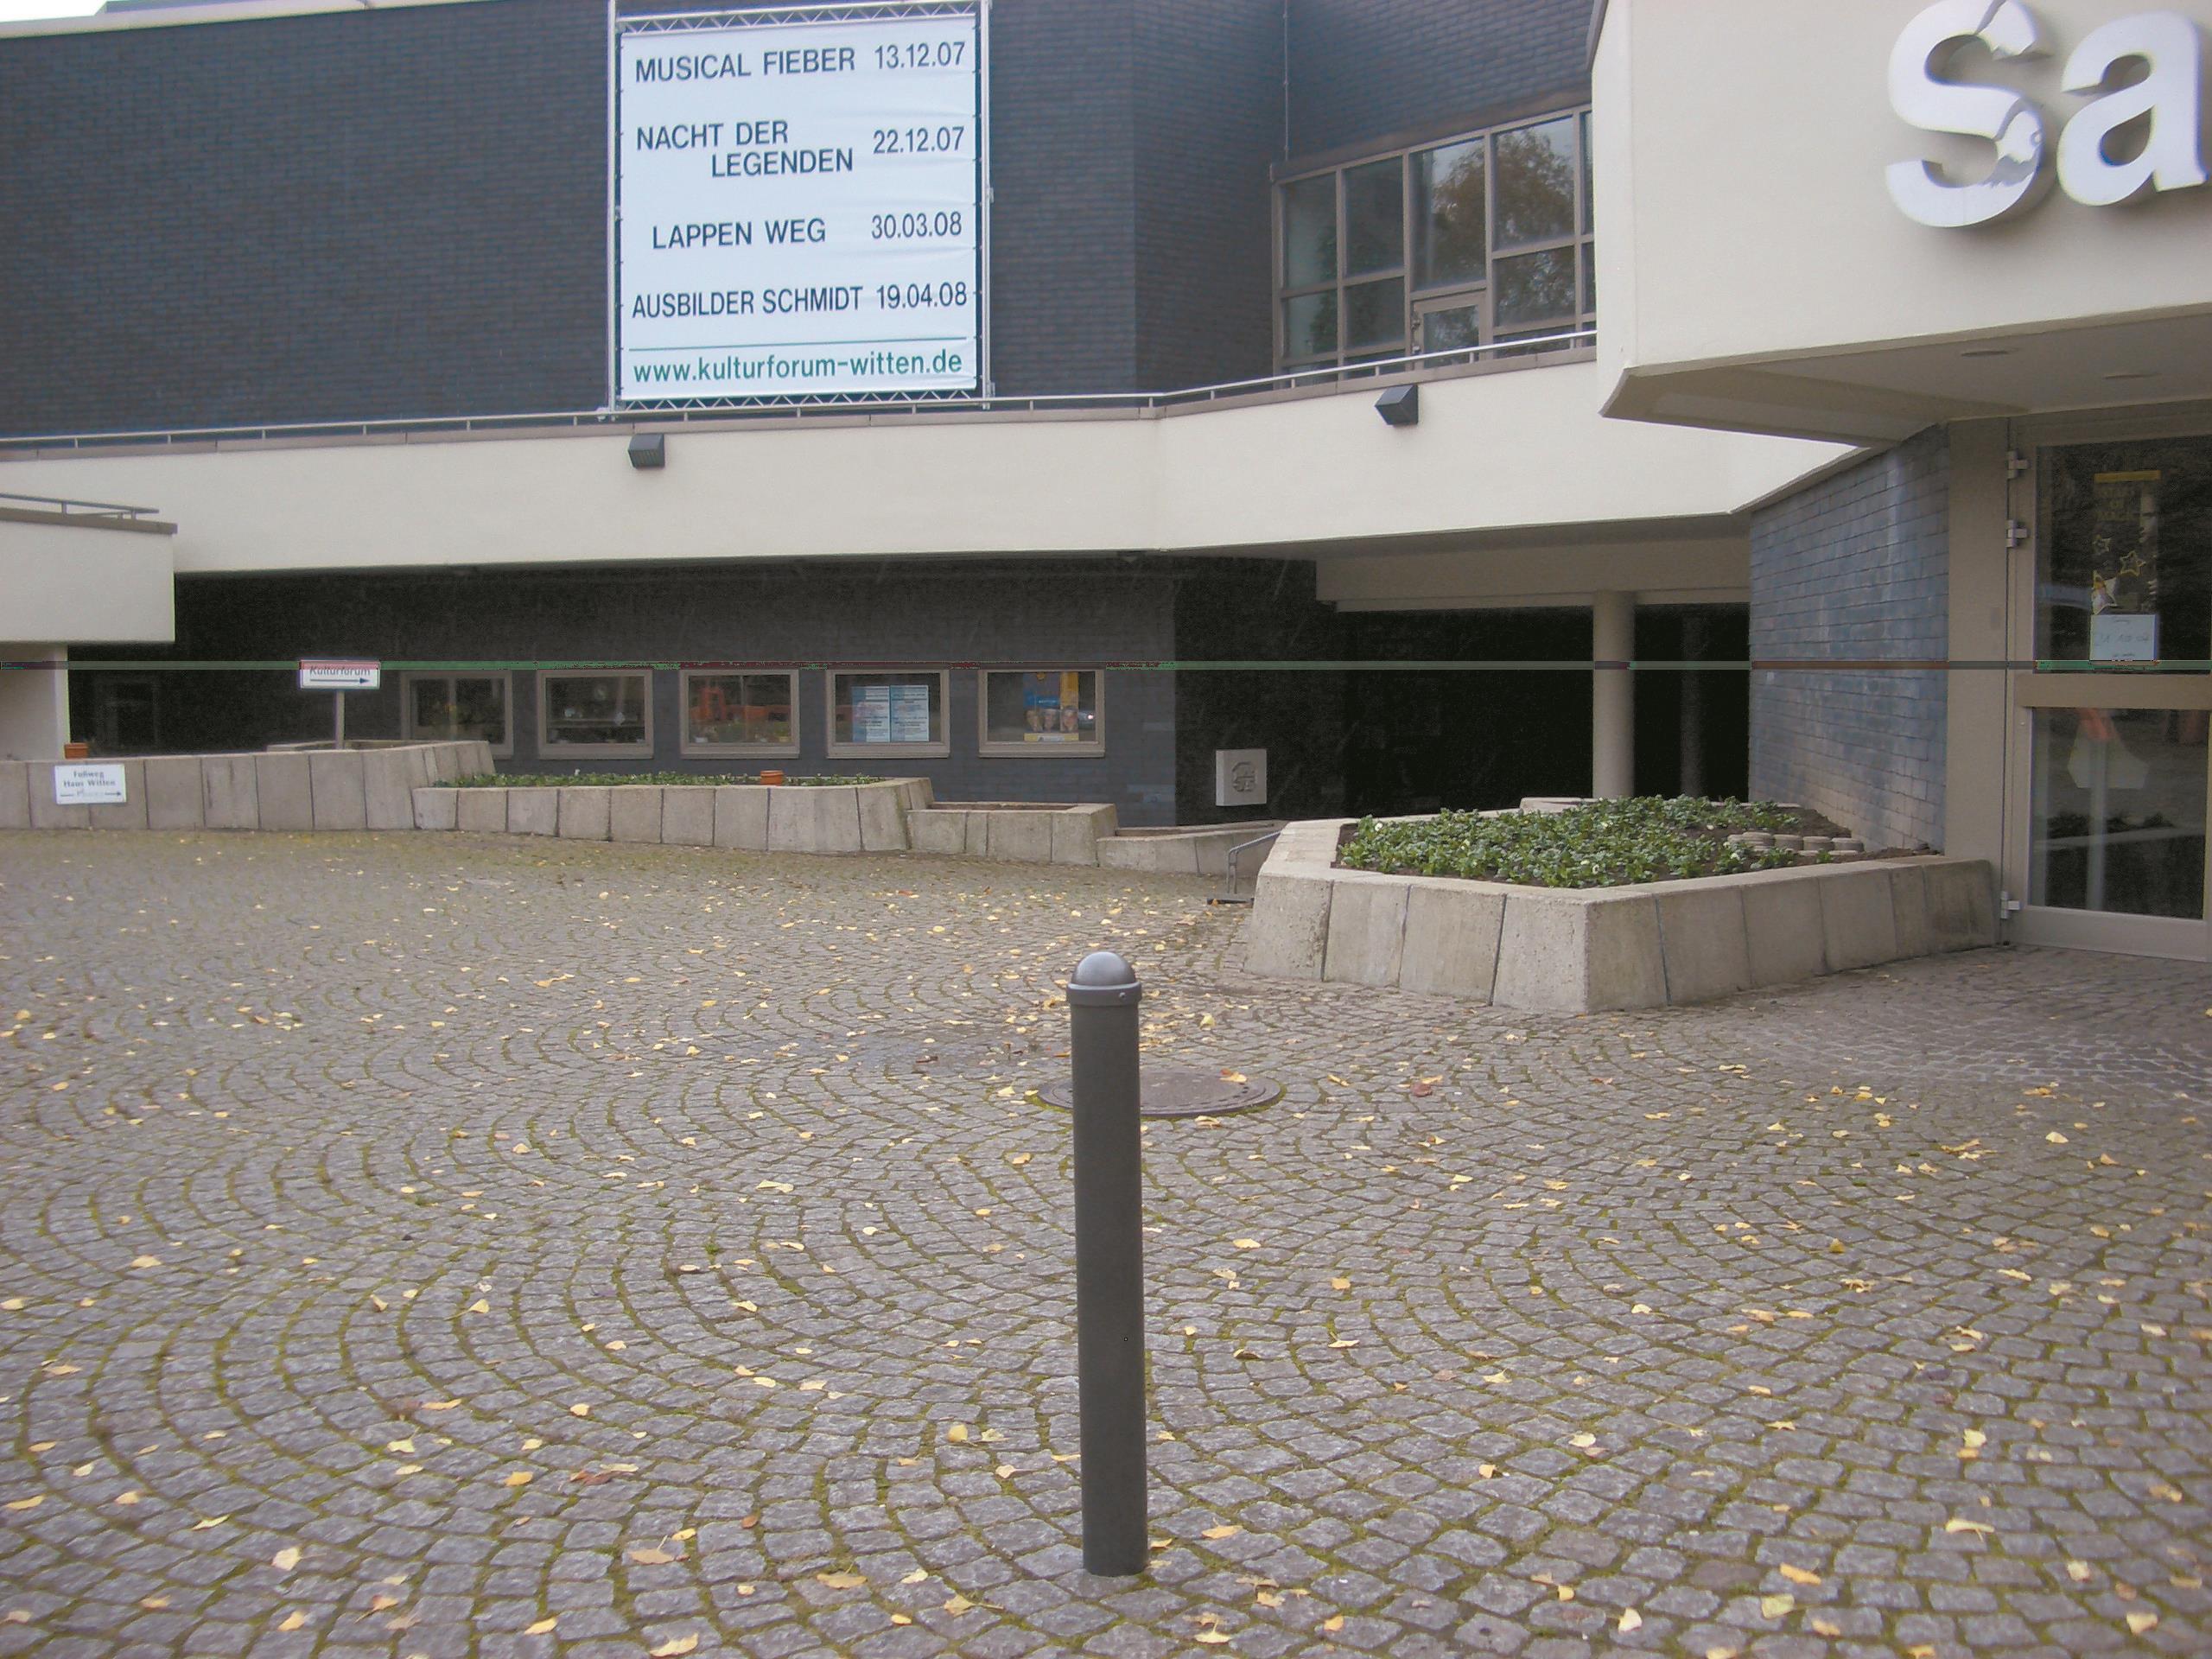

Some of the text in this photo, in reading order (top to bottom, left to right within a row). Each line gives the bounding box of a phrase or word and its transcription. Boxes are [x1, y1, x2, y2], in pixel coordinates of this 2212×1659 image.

[636, 41, 965, 82] MUSICAL FIEBER 13.12.07
[637, 120, 789, 150] NACHT DER
[873, 126, 964, 154] 22.12.07
[712, 148, 854, 178] LEGENDEN
[652, 212, 963, 250] LAPPEN WEG 30.03.08
[632, 281, 968, 318] AUSBILDER SCHMIDT 19.04.08
[633, 349, 963, 383] www.kulturforum-witten.de
[309, 664, 371, 676] Kulturforum
